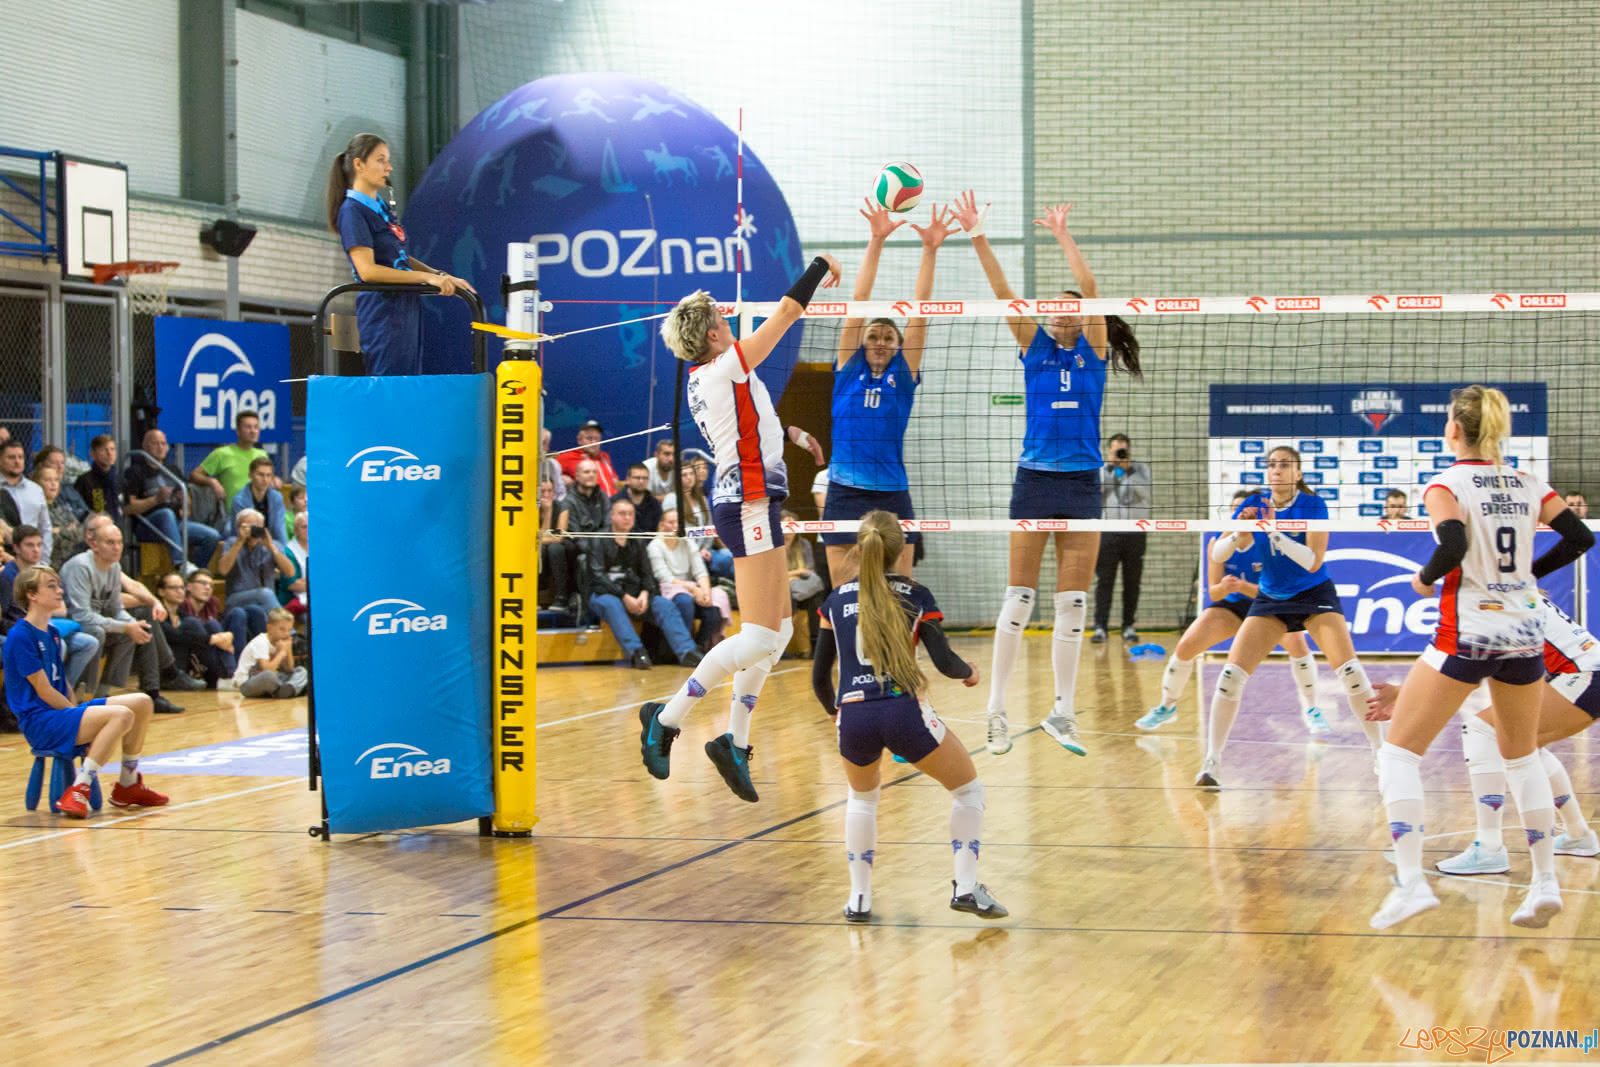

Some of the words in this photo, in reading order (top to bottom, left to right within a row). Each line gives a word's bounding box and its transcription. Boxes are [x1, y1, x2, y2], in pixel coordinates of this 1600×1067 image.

[807, 304, 846, 314] ORLEN
[921, 303, 962, 313] ORLEN
[1038, 302, 1079, 312] ORLEN
[1156, 300, 1198, 310] ORLEN
[1277, 299, 1319, 309] ORLEN
[1398, 297, 1442, 307] ORLEN
[1521, 296, 1565, 307] ORLEN
[194, 373, 276, 430] Enea
[361, 460, 441, 481] Enea
[501, 404, 524, 526] SPORT
[753, 526, 763, 541] 3
[1496, 526, 1517, 573] 9
[368, 613, 448, 635] Enea
[501, 573, 524, 772] TRANSFER
[370, 757, 451, 779] Enea
